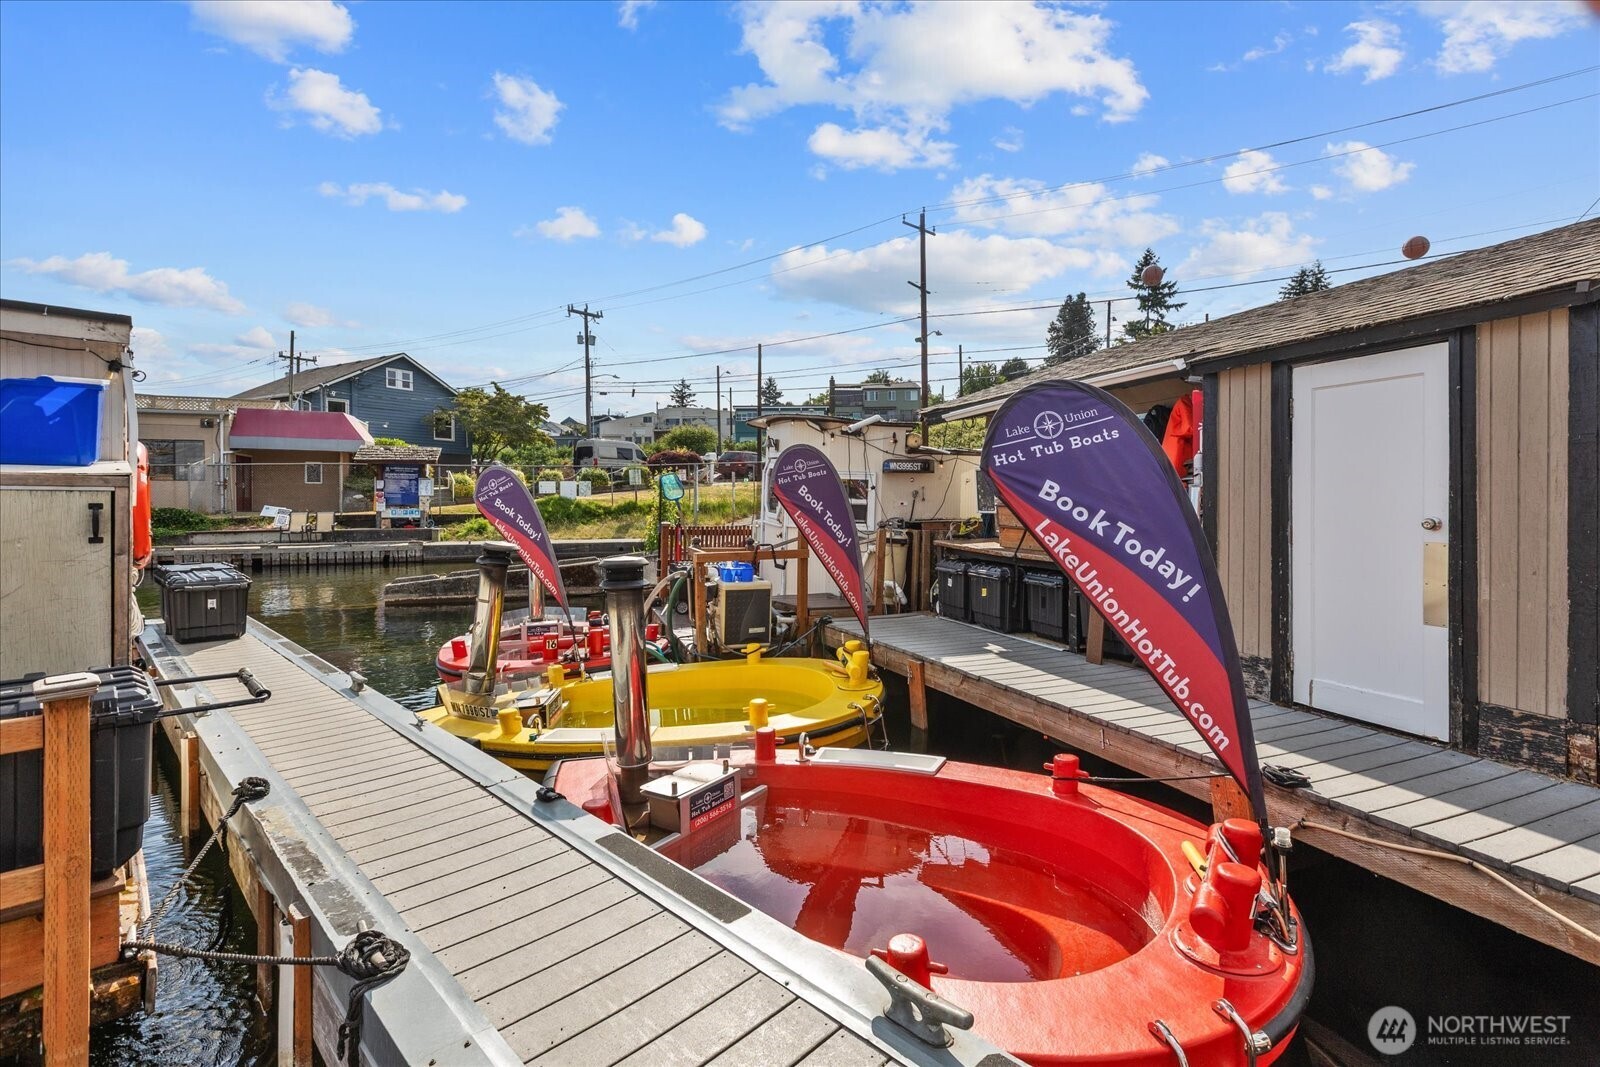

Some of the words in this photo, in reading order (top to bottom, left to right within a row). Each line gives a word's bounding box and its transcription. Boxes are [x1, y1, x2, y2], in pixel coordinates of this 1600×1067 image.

[1005, 424, 1031, 438] Lake
[1063, 406, 1099, 424] Union
[993, 448, 1026, 467] Hot
[1031, 441, 1064, 457] Tub
[1070, 428, 1120, 450] Boats
[778, 477, 791, 485] Hot
[793, 473, 807, 481] Tub
[807, 469, 827, 479] Boats
[494, 497, 516, 519] Book
[515, 513, 542, 541] Today!
[798, 484, 824, 514] Book
[823, 510, 852, 547] Today!
[1038, 479, 1111, 537] Book
[1113, 521, 1202, 603] Today!
[793, 510, 860, 612] LakeUnionHotTub.com
[547, 640, 557, 649] 16
[1034, 518, 1231, 751] LakeUnionHotTub.com
[691, 810, 701, 818] Hot
[701, 804, 711, 813] Tub
[694, 816, 709, 828] (206)
